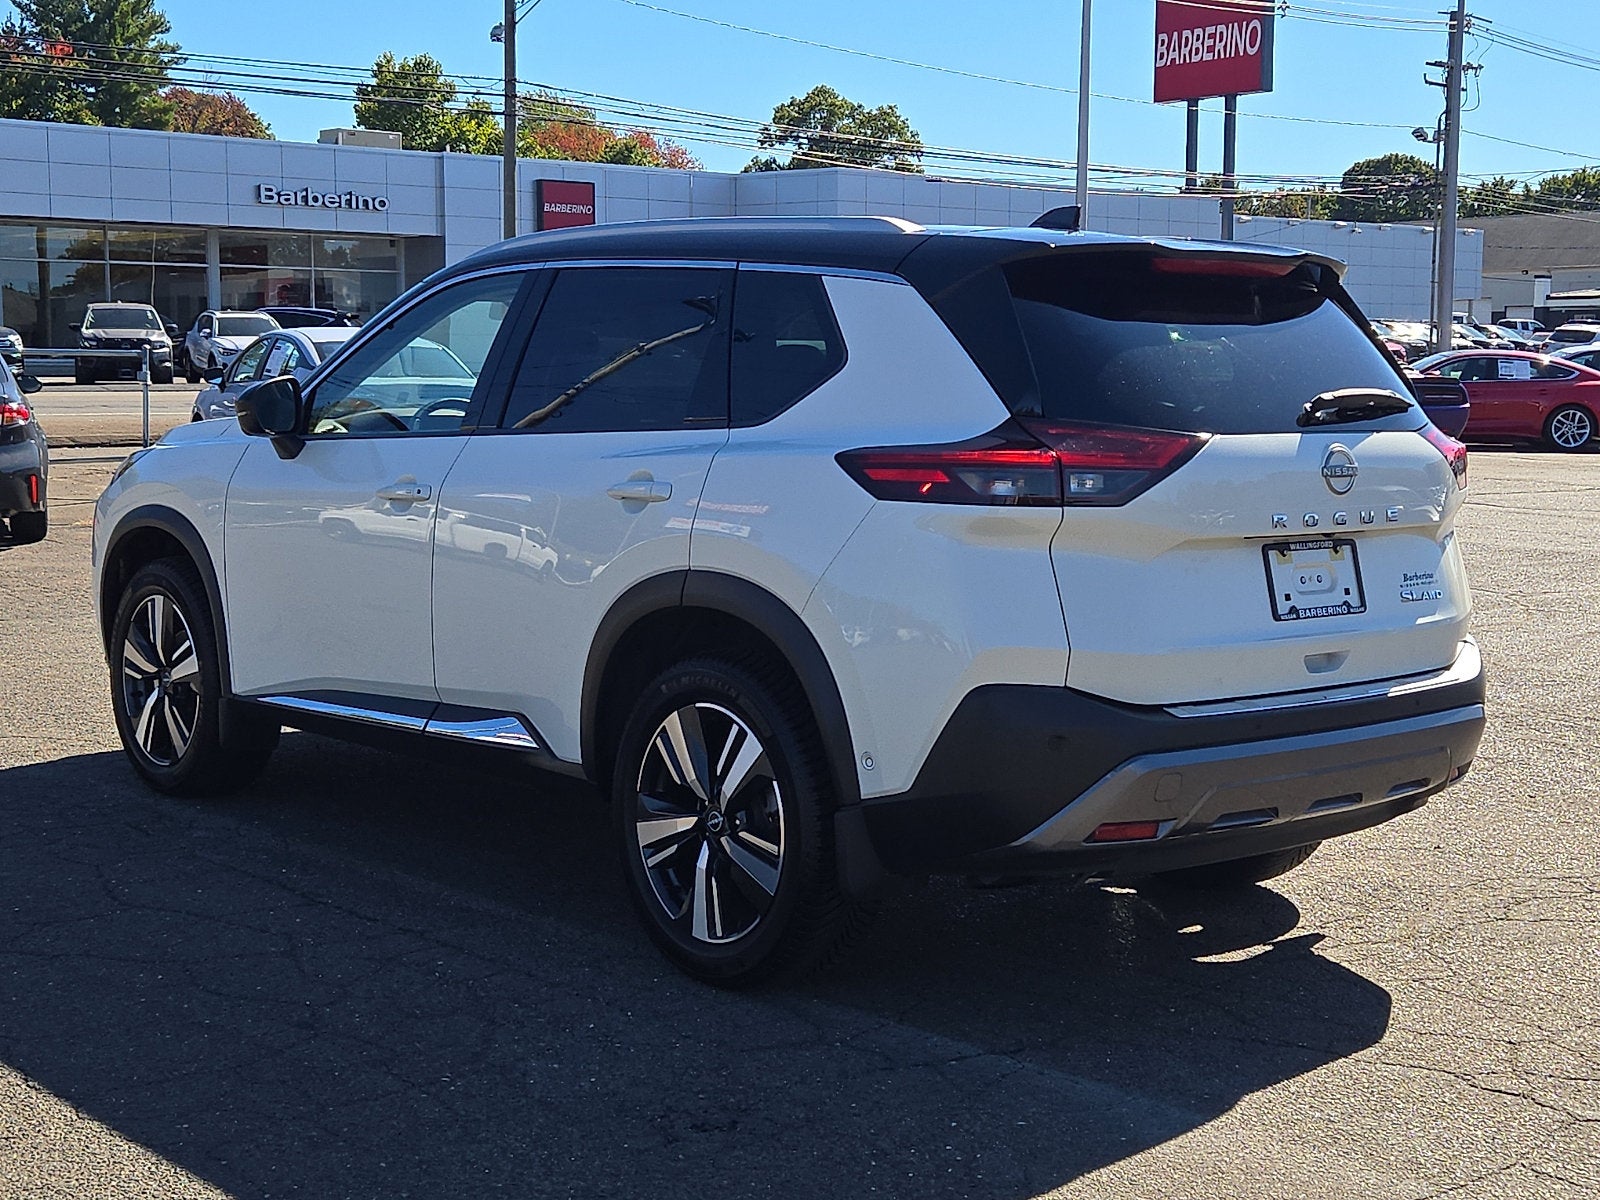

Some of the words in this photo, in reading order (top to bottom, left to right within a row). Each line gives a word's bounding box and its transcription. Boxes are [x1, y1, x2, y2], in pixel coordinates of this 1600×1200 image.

[1156, 19, 1262, 68] BARBERINO
[257, 183, 390, 211] Barberino
[543, 202, 593, 214] BARBERINO
[1323, 466, 1359, 476] NISSAN
[1271, 507, 1399, 528] ROGUE
[1289, 541, 1334, 550] WALLINGFORD
[1403, 571, 1434, 582] Barberino
[1299, 605, 1348, 618] BARBERINO
